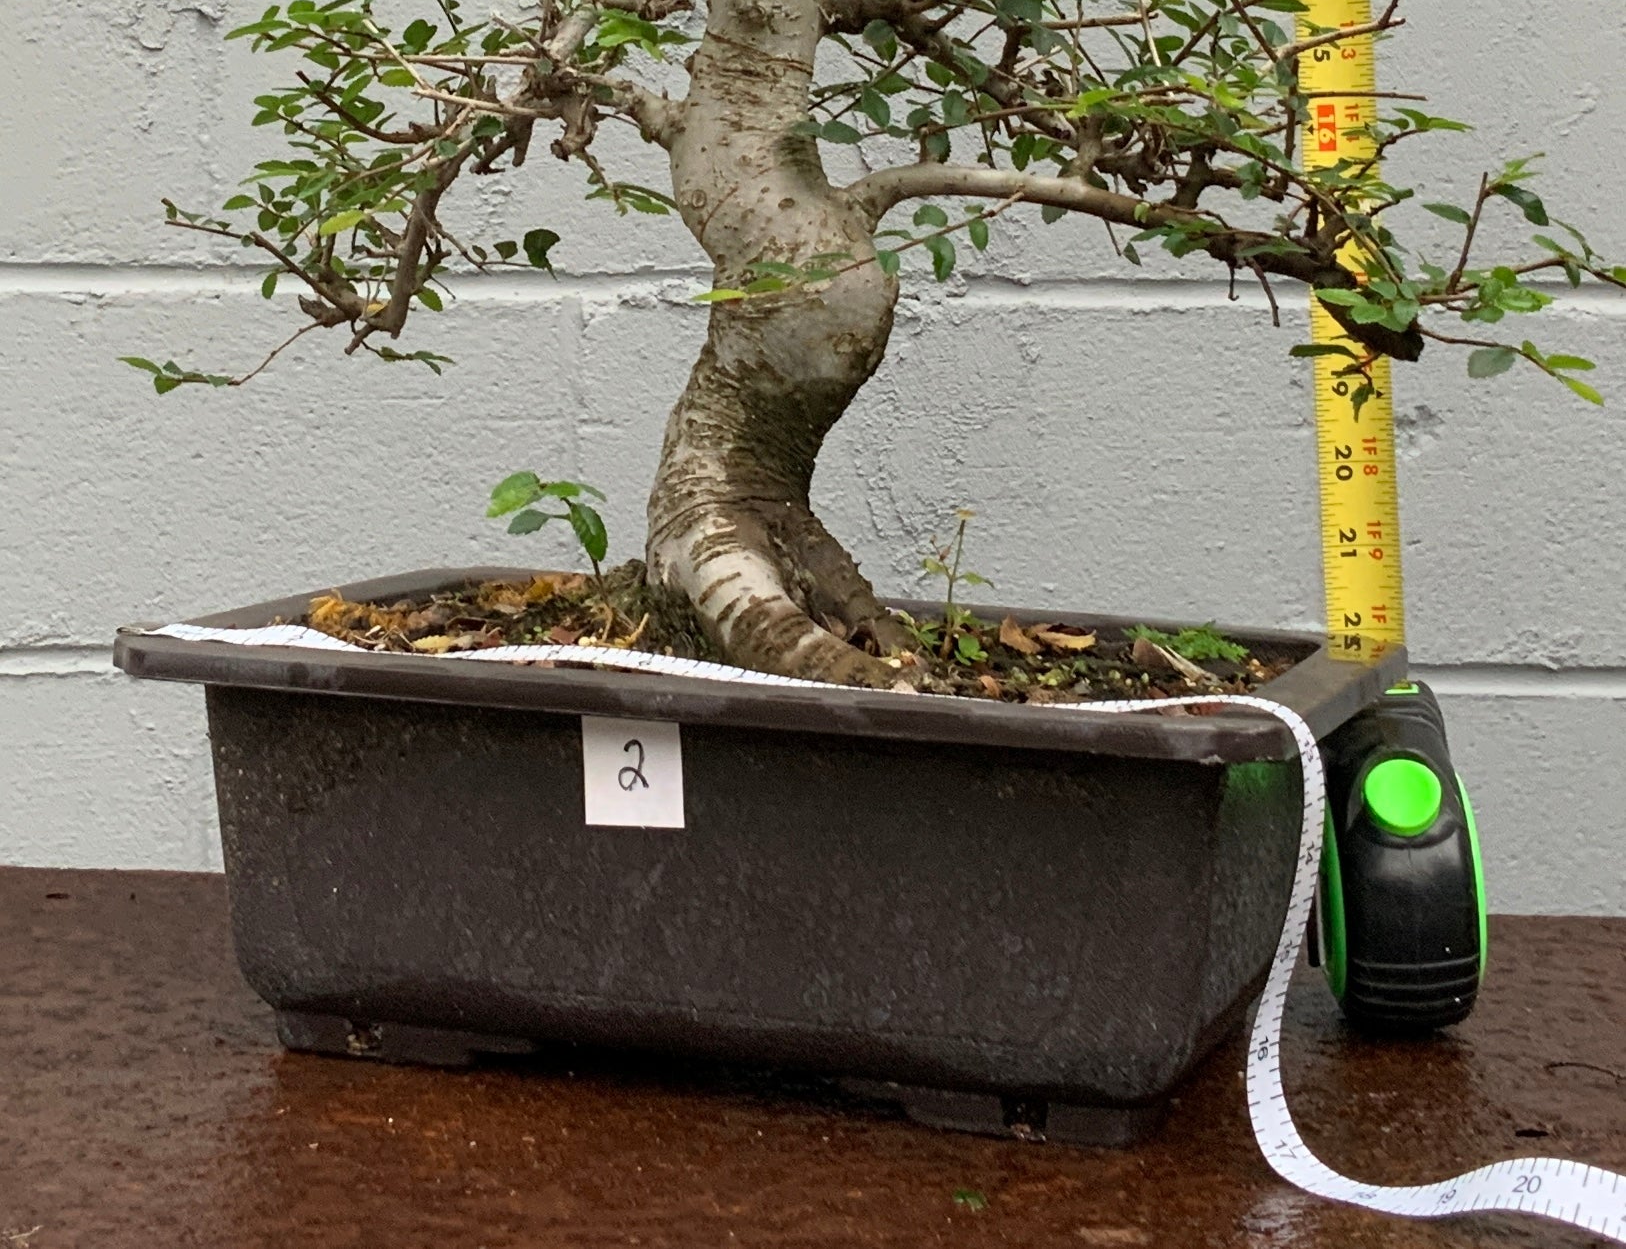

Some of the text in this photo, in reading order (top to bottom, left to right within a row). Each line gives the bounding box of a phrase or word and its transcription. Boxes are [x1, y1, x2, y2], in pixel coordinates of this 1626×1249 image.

[1319, 114, 1335, 144] 16
[1335, 445, 1354, 481] 20
[1339, 528, 1357, 558] 21
[618, 739, 649, 791] 2
[1257, 1036, 1269, 1062] 16
[1512, 1175, 1542, 1194] 20
